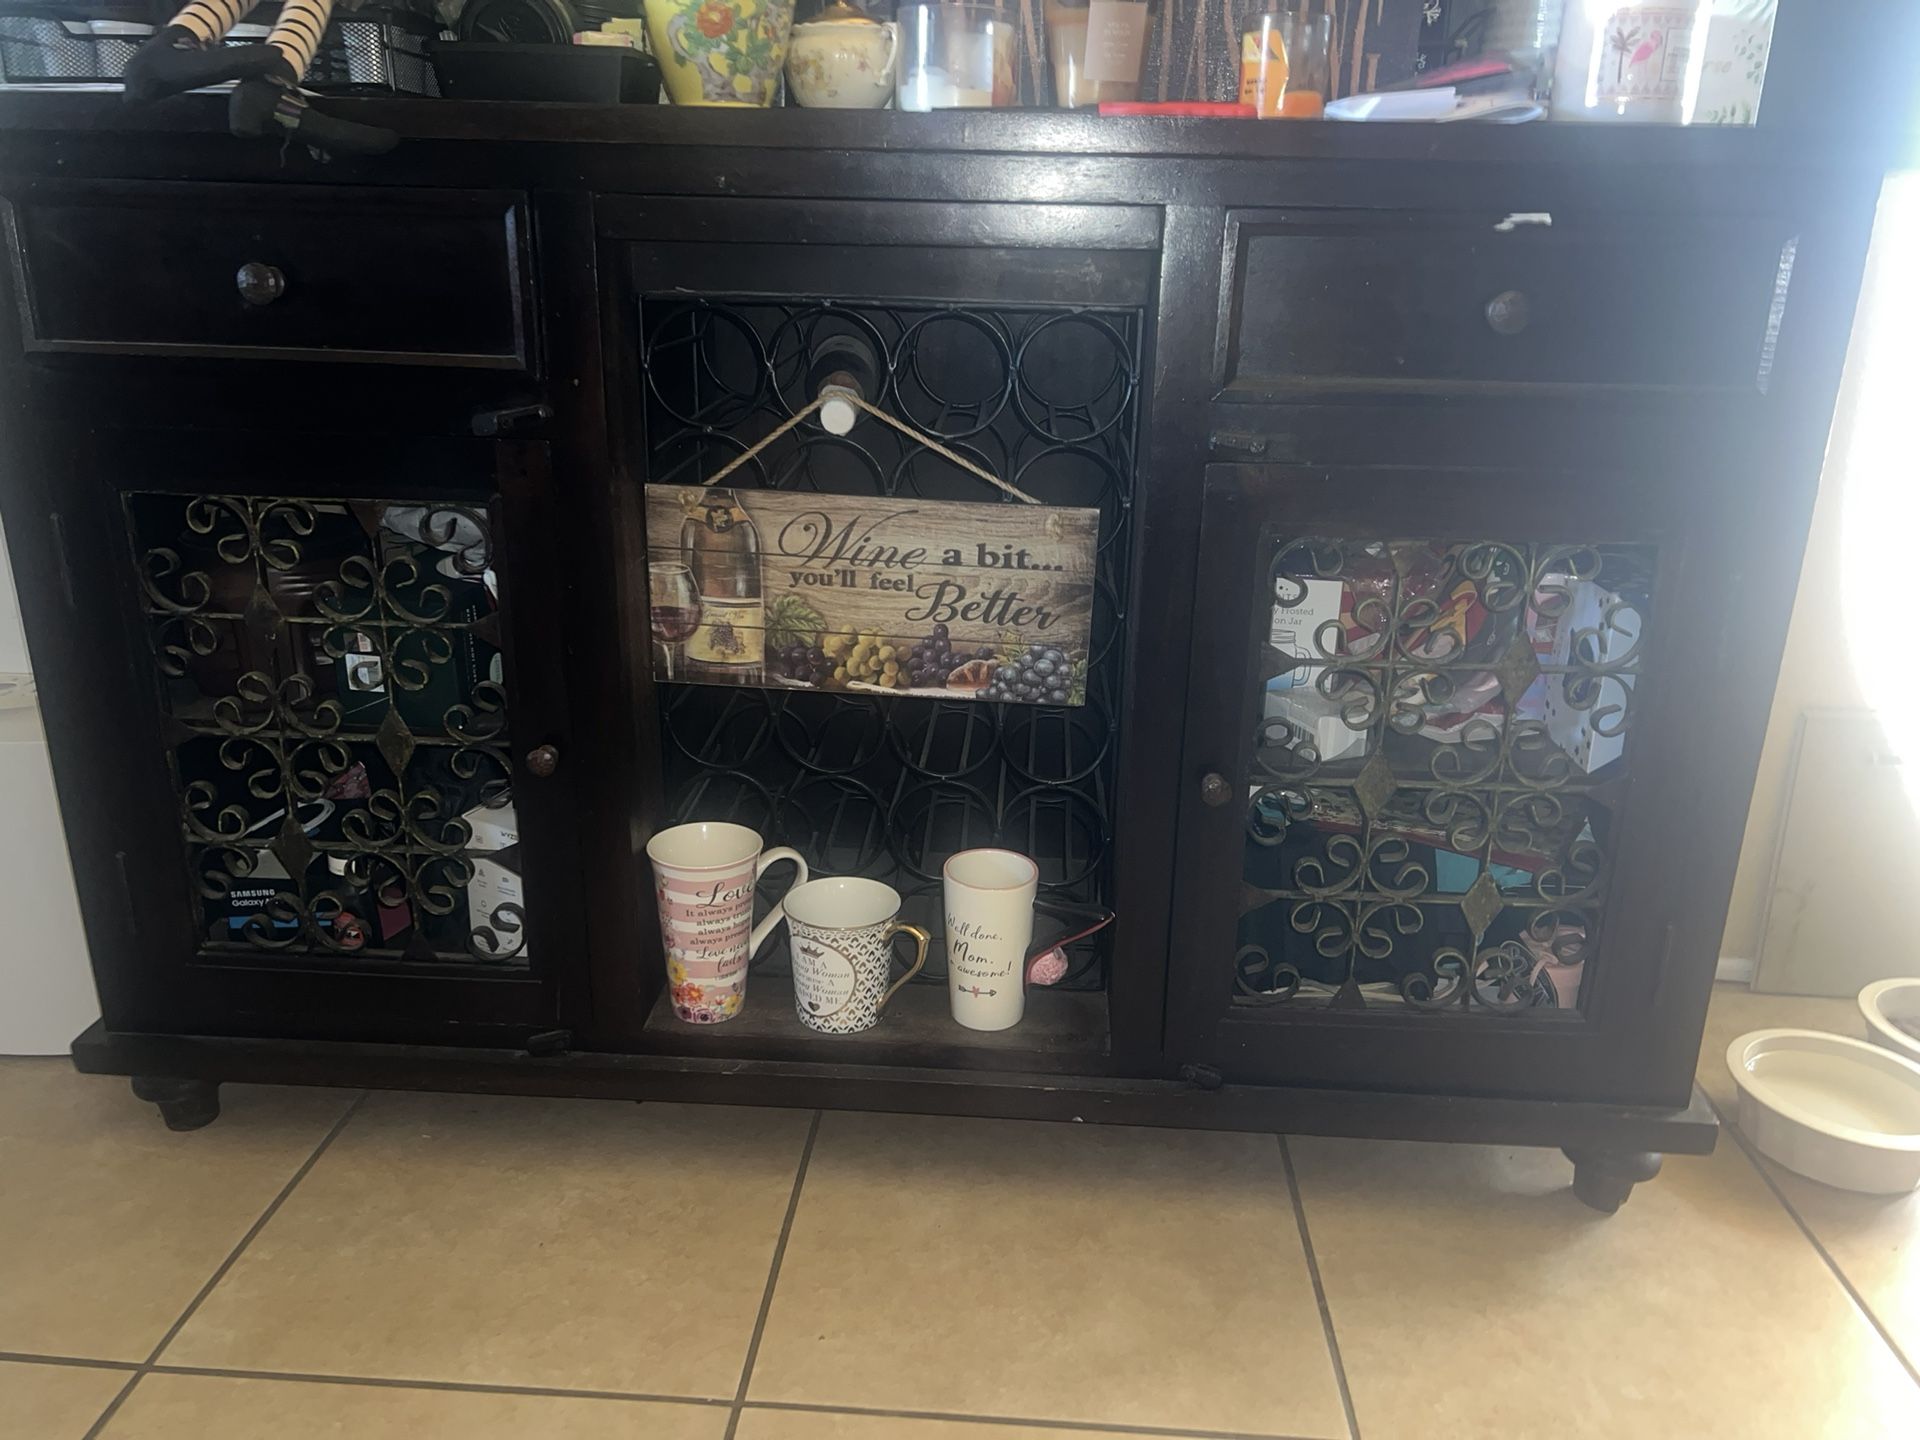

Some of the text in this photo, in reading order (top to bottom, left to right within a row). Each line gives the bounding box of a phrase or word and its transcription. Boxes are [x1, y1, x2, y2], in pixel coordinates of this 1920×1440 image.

[778, 509, 1064, 573] Wine a bit...
[788, 568, 914, 594] you'll feel
[904, 579, 1062, 631] Better
[1288, 617, 1302, 625] Jar
[230, 889, 275, 898] SAMSUNG
[695, 881, 754, 909] Love
[231, 899, 264, 907] Galaxy
[697, 906, 733, 918] always
[696, 917, 731, 927] always
[697, 926, 731, 937] always
[689, 935, 723, 947] always
[957, 961, 1012, 977] awesome!
